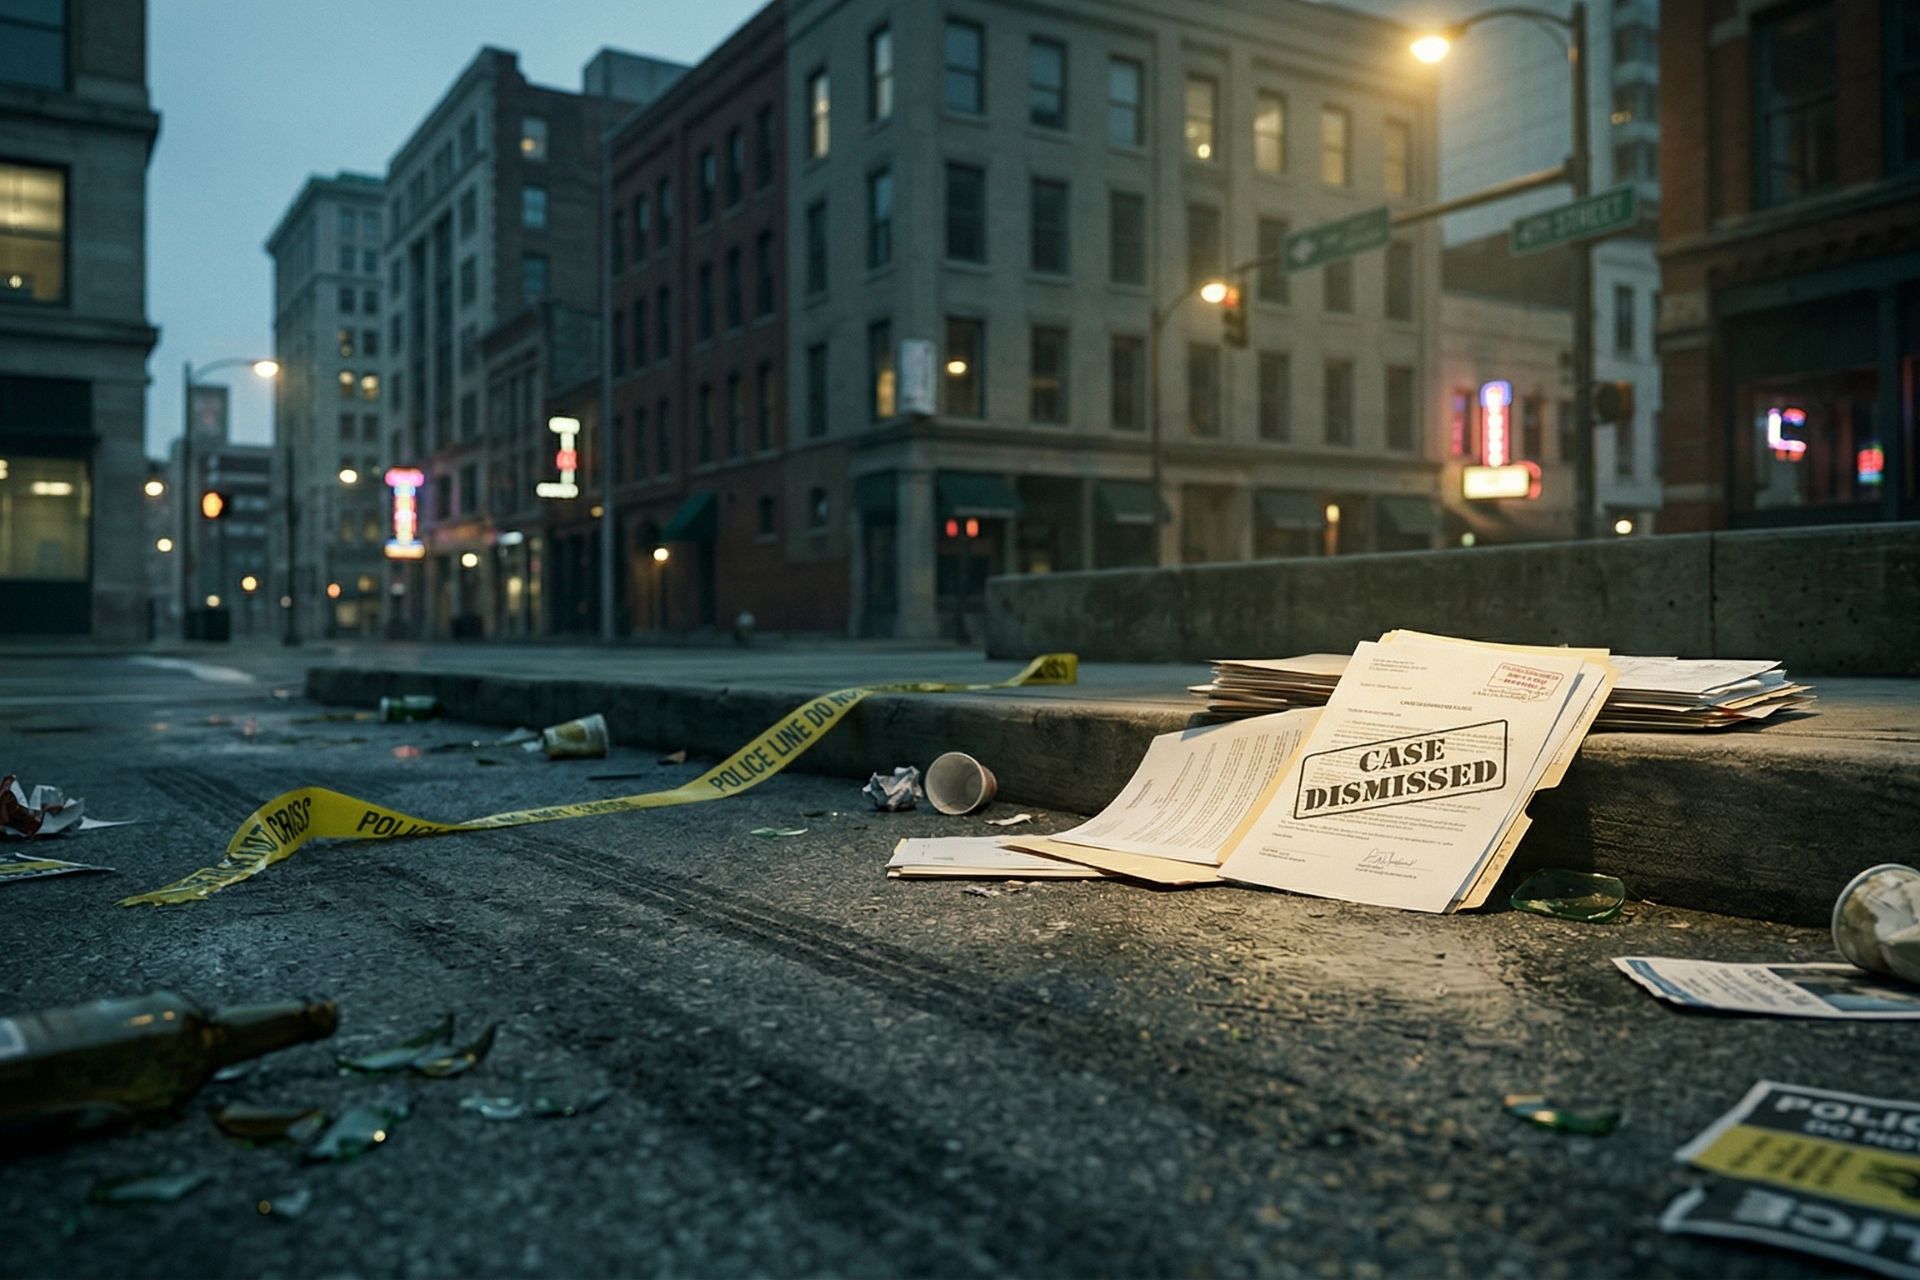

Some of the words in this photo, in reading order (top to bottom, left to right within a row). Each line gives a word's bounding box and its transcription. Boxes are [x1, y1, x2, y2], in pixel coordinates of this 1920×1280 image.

[708, 746, 777, 793] POLICE
[766, 718, 813, 758] LINE
[803, 701, 835, 729] DO
[1359, 738, 1446, 773] CASE
[1304, 759, 1498, 811] DISMISSED
[1774, 1094, 1920, 1135] POLIC
[1862, 1129, 1920, 1151] NO
[1732, 1187, 1920, 1263] LICE
